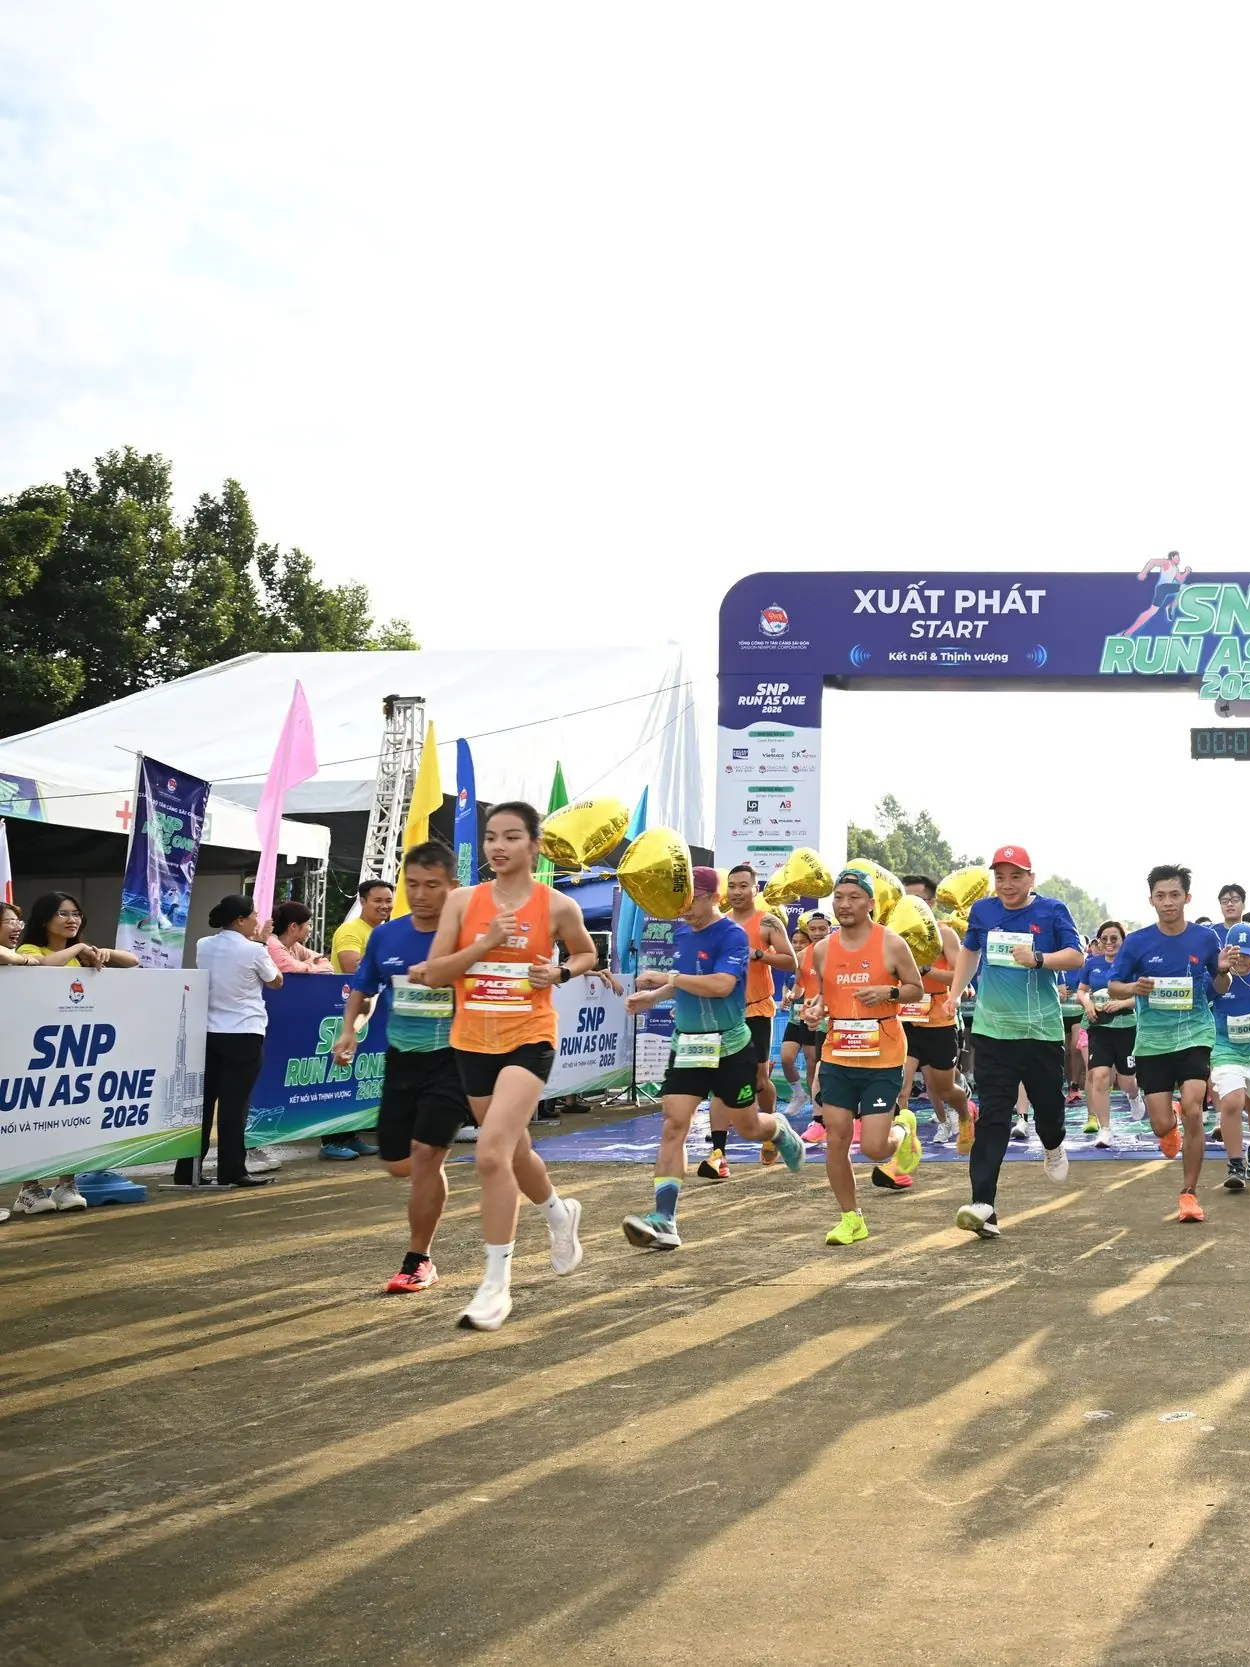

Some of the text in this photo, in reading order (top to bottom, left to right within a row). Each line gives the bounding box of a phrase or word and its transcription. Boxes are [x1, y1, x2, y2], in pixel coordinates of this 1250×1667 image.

[853, 581, 1046, 614] XUẤT PHÁT
[910, 620, 989, 638] START
[889, 651, 1009, 664] Kết nối & Thịnh vượng
[1100, 636, 1203, 674] RUN
[756, 683, 790, 696] SNP
[738, 696, 807, 705] RUN AS ONE
[762, 706, 782, 714] 2026
[475, 980, 521, 989] PACER
[837, 973, 870, 985] PACER
[1160, 990, 1191, 998] 50407
[577, 1007, 606, 1033] SNP
[28, 1024, 117, 1070] SNP
[560, 1033, 618, 1056] RUN AS ONE
[599, 1053, 616, 1067] 2026
[284, 1057, 328, 1087] RUN
[0, 1069, 157, 1112] UN AS ONE
[19, 1121, 32, 1132] VÀ
[33, 1119, 60, 1132] THỊNH
[62, 1116, 91, 1129] VƯỢNG
[101, 1104, 150, 1130] 2026
